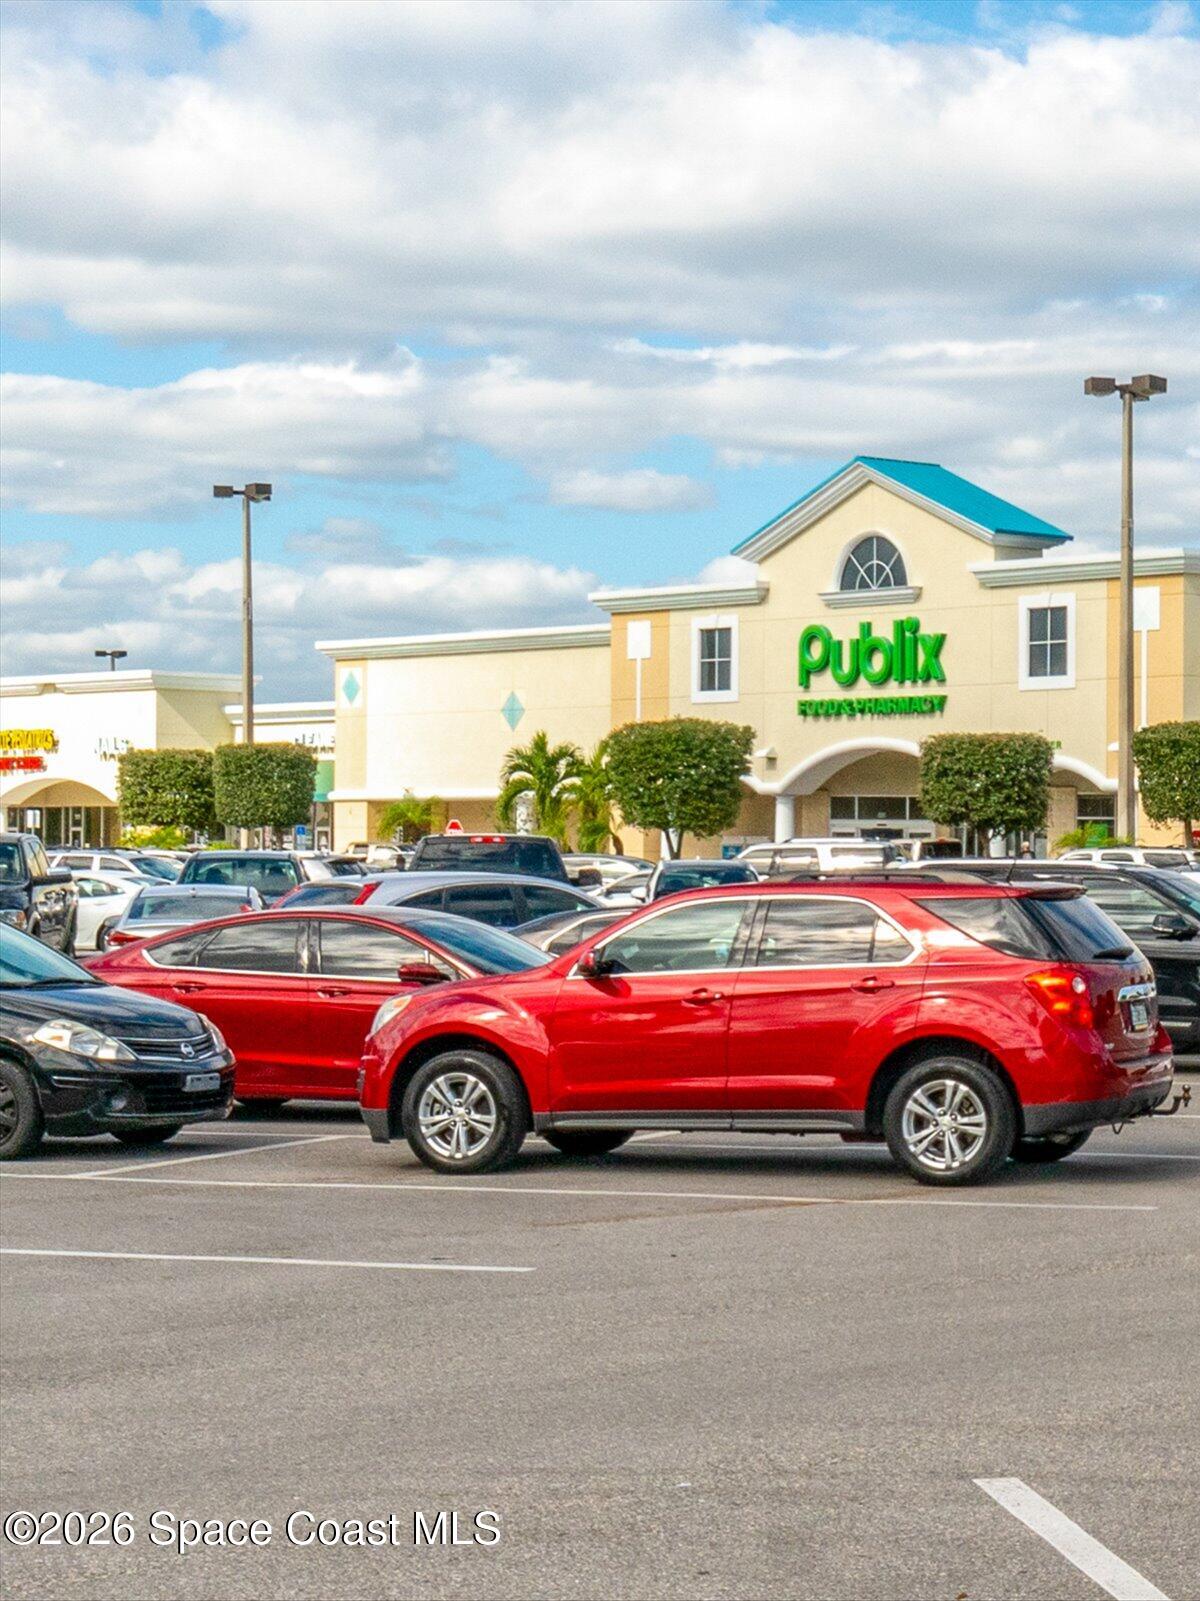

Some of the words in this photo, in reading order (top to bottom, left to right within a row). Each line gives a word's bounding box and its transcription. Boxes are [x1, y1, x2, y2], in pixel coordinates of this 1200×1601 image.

[798, 616, 948, 689] Publix
[797, 699, 841, 716] FOOD
[841, 699, 856, 716] &
[855, 695, 948, 715] PHARMACY
